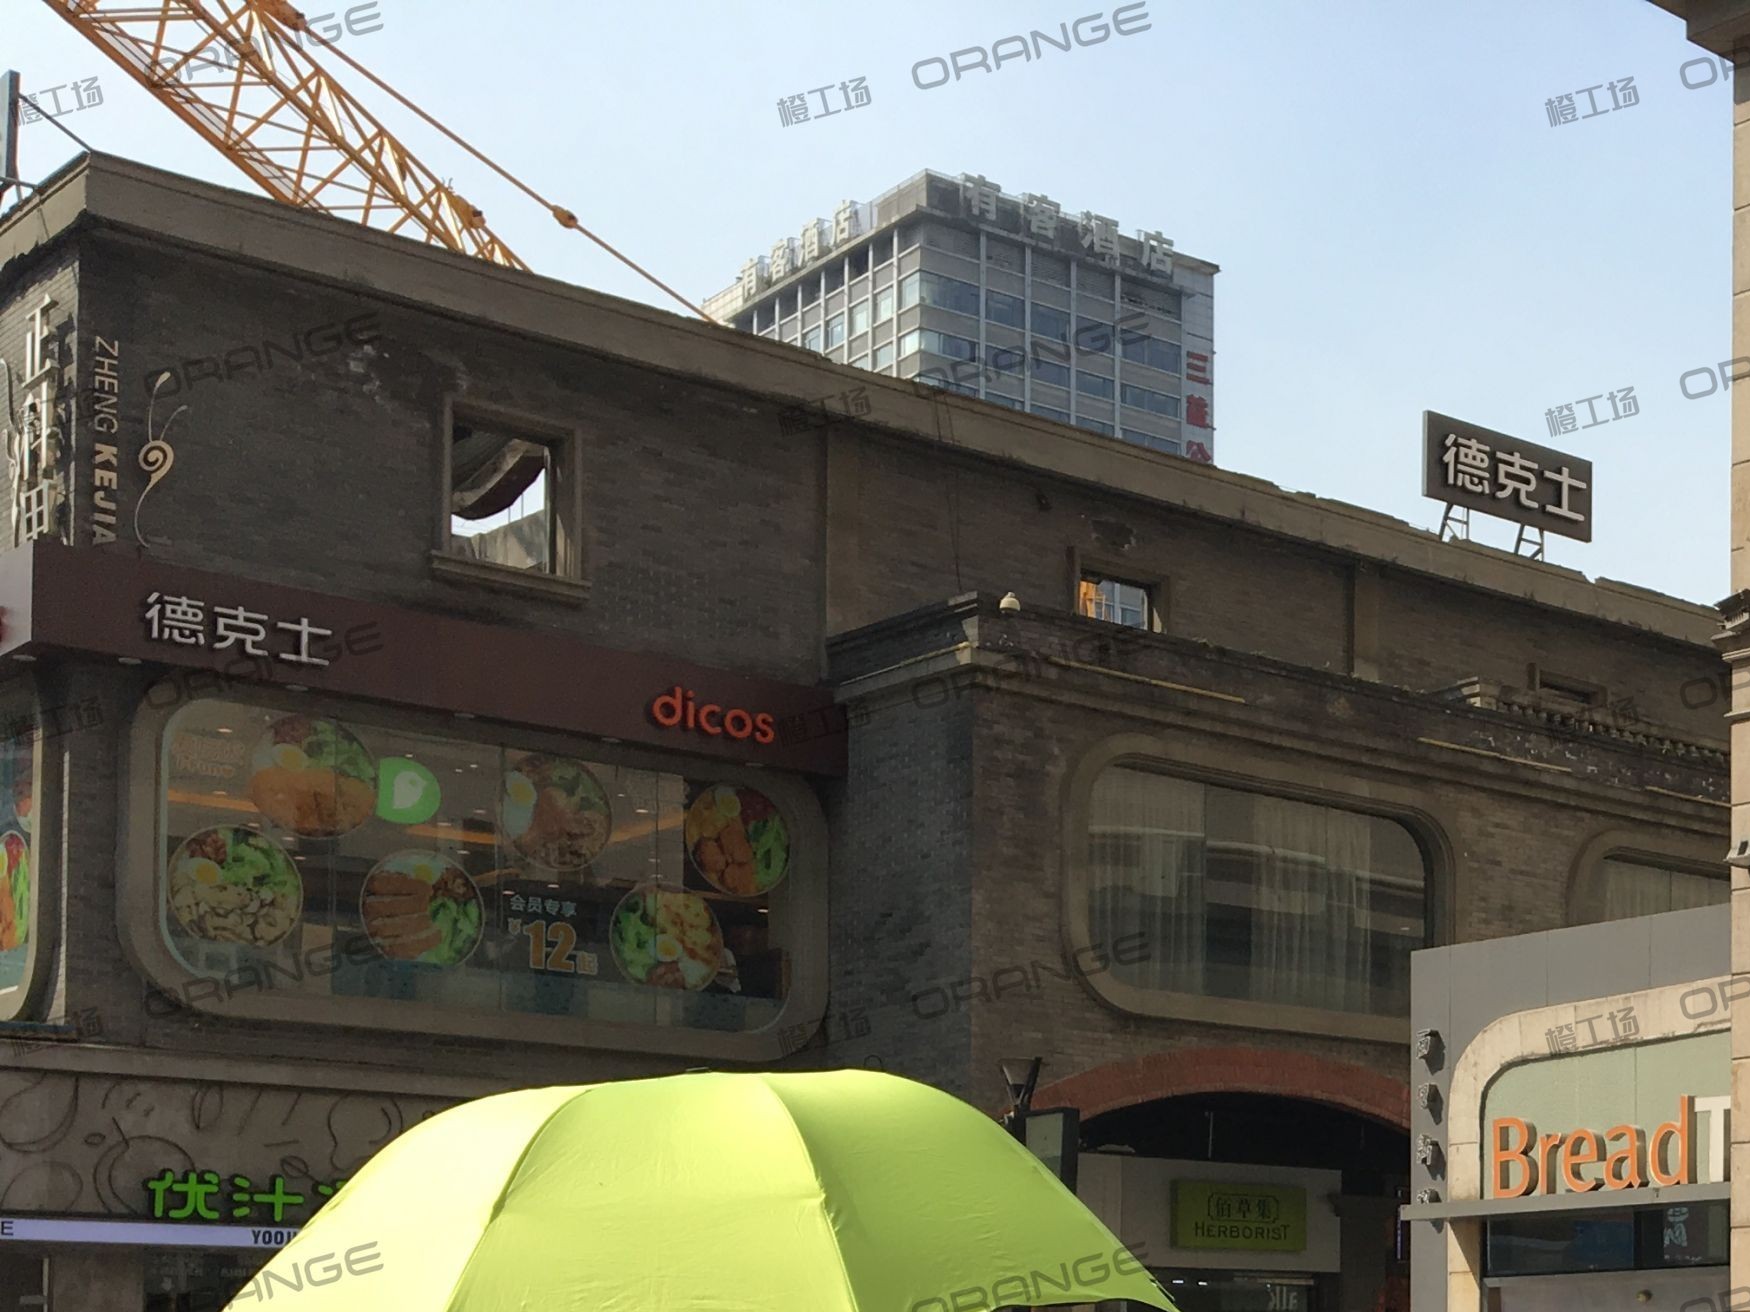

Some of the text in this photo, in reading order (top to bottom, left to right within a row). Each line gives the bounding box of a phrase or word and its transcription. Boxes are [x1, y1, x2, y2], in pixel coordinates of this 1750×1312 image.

[961, 173, 1175, 280] 有客酒店
[92, 336, 119, 546] ZHENG KEJIA
[1442, 433, 1588, 522] 德克士
[145, 591, 333, 666] 德克士
[652, 686, 775, 744] dicos
[147, 1169, 346, 1222] 优汁
[251, 1228, 298, 1246] YOO
[1194, 1221, 1290, 1242] HERBORIST
